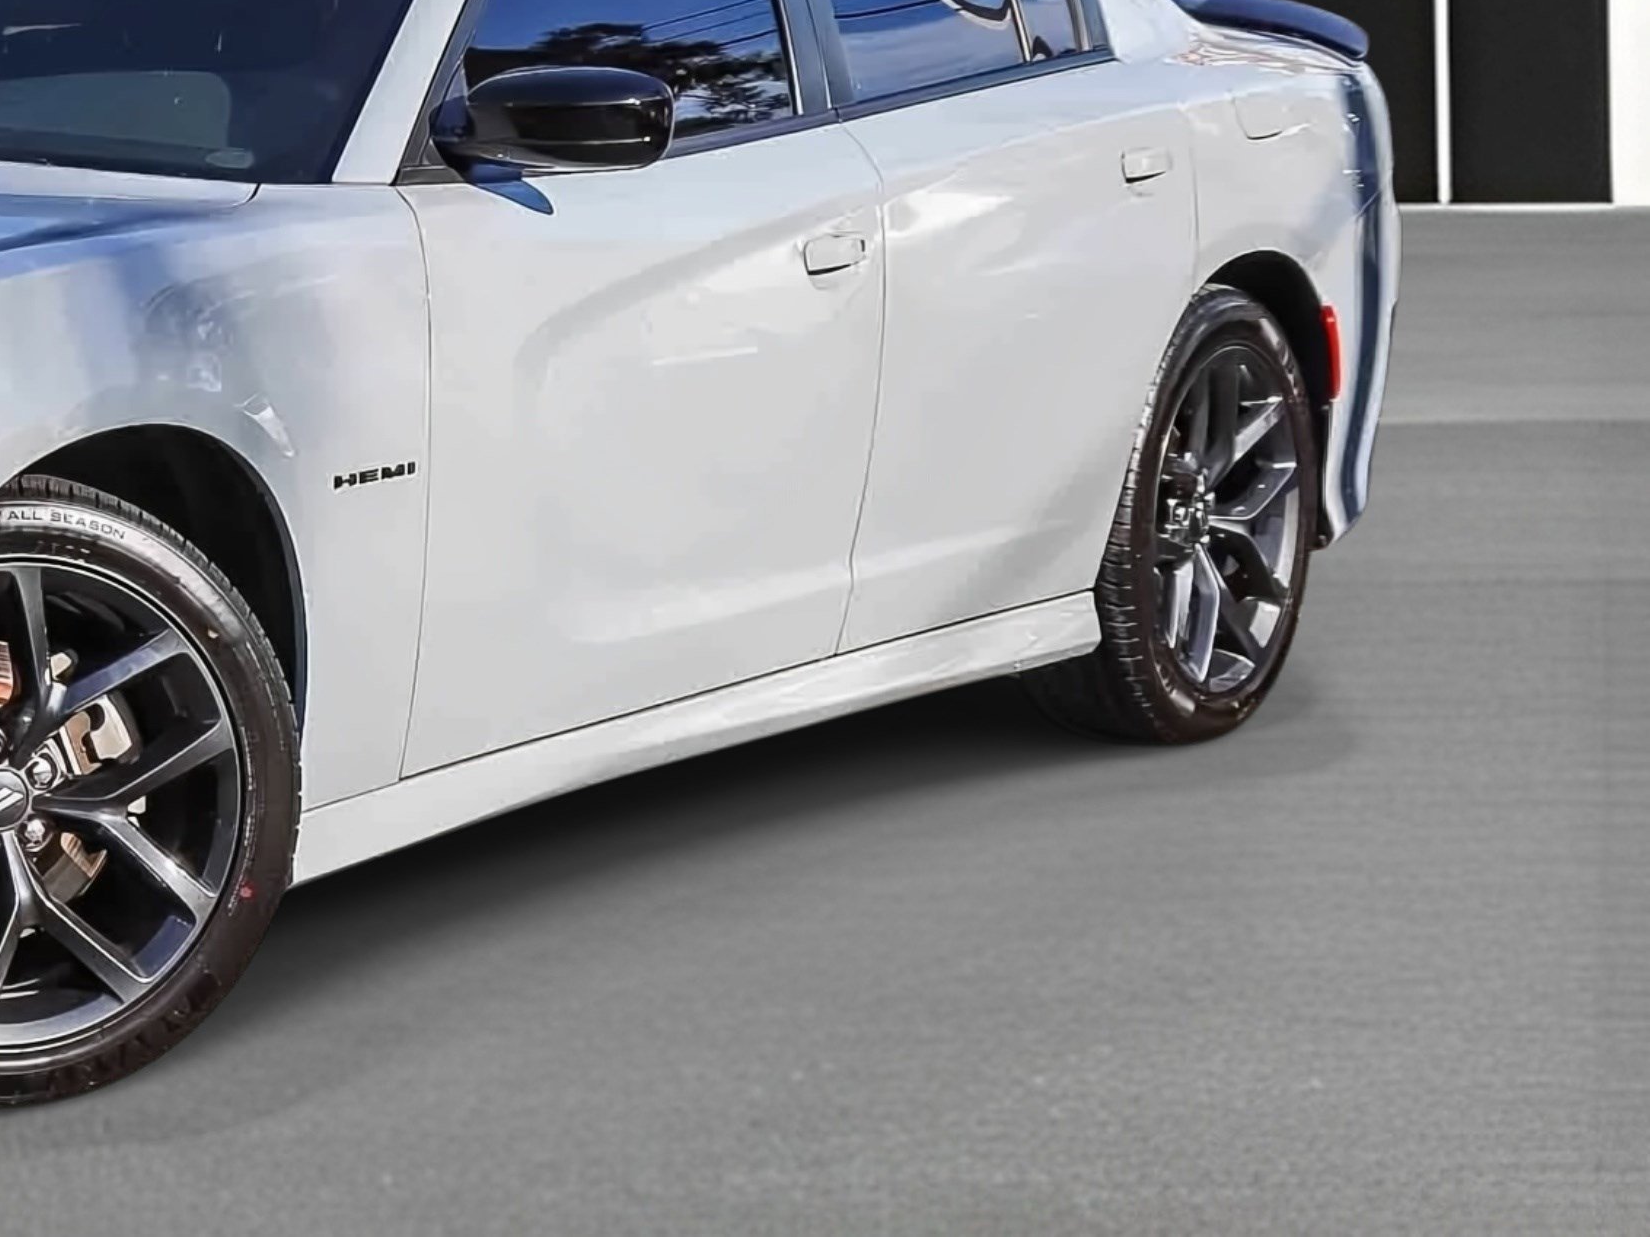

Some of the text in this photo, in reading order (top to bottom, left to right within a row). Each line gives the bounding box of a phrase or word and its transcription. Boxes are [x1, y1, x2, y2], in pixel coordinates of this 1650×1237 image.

[334, 461, 416, 490] HEMI
[6, 509, 126, 541] ALL SEASON
